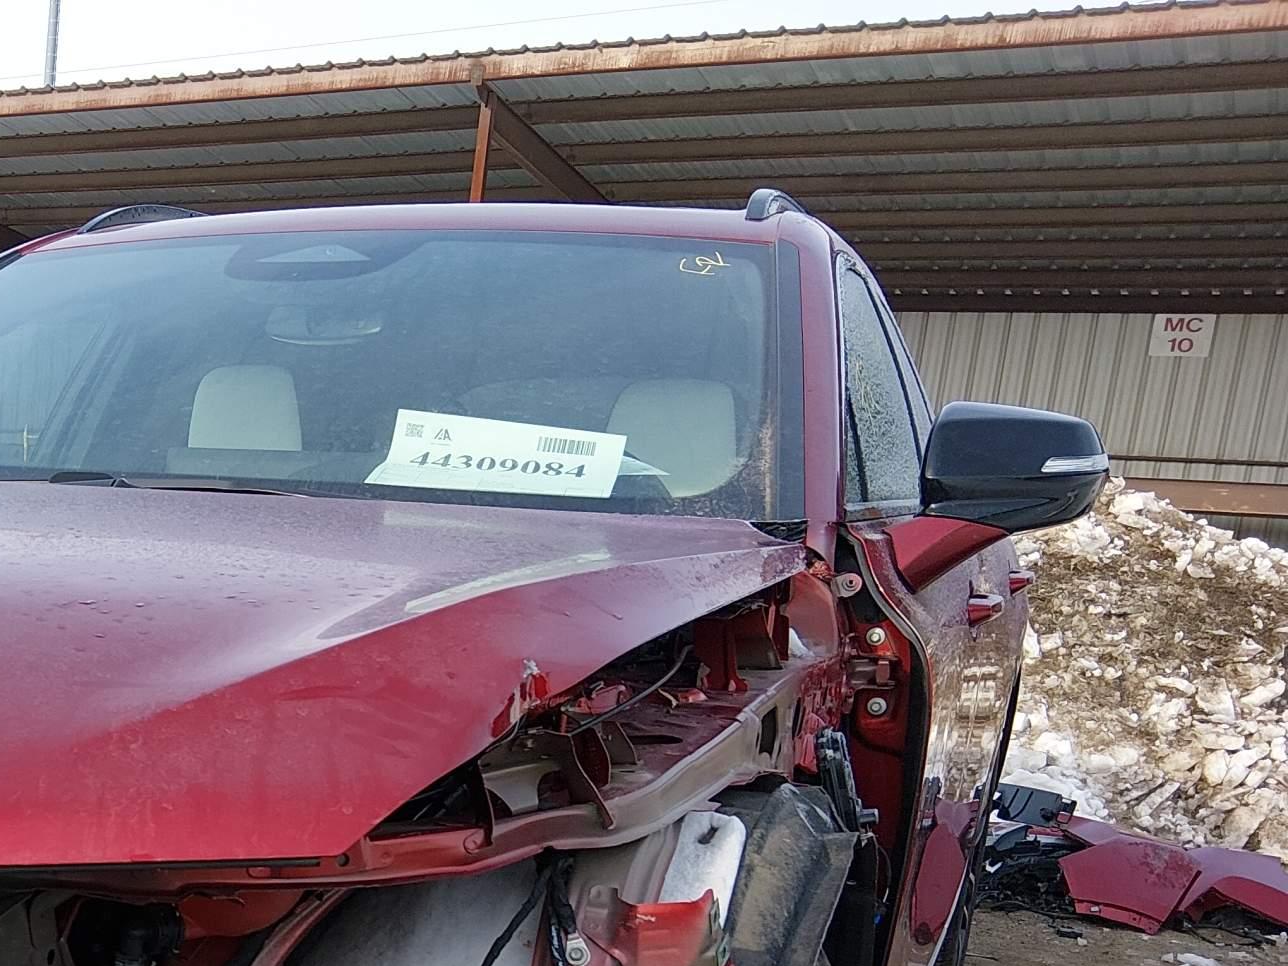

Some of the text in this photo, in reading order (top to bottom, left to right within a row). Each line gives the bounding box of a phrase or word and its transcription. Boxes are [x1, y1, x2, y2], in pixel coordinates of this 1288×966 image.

[1163, 317, 1204, 333] MC
[1167, 337, 1194, 353] 10
[409, 451, 587, 479] 44309084
